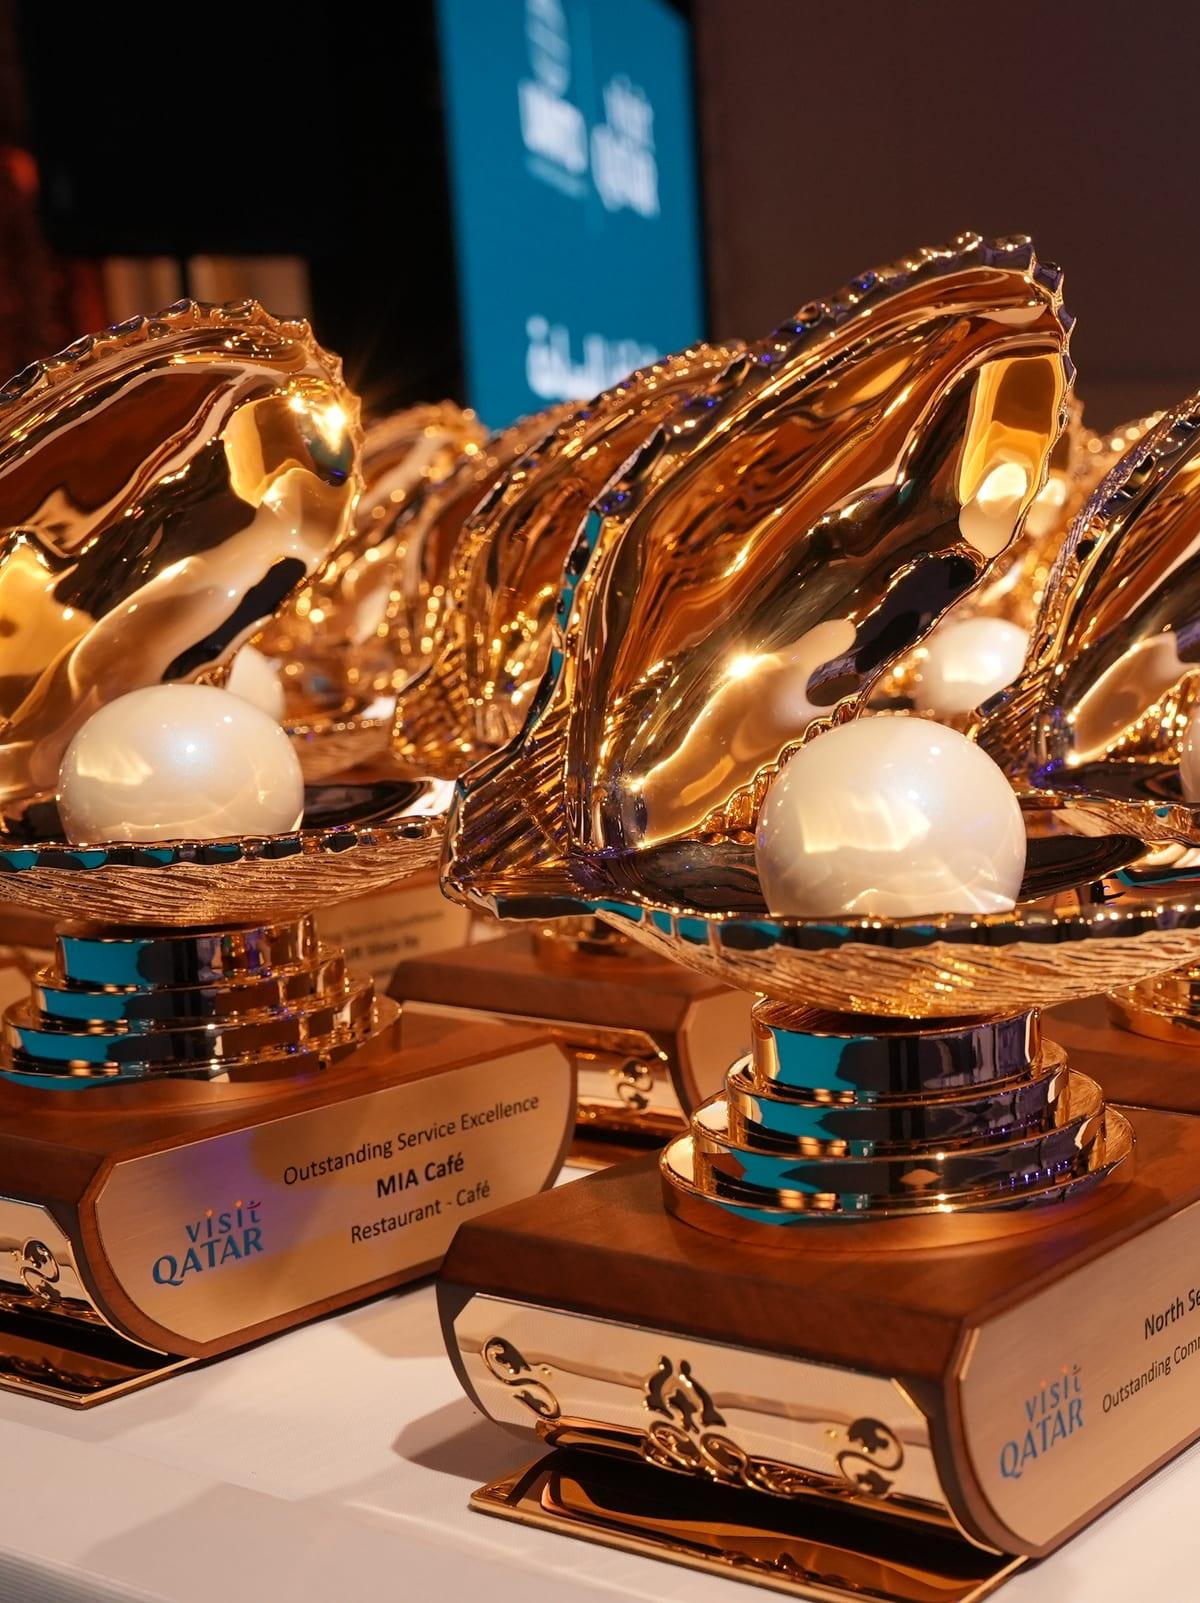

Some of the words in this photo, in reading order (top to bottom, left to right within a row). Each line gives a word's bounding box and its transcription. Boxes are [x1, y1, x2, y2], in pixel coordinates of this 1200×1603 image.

[283, 1137, 393, 1187] Outstanding
[397, 1121, 456, 1152] Service
[460, 1095, 540, 1131] Excellence
[376, 1168, 419, 1200] MIA
[424, 1153, 465, 1183] Café
[351, 1199, 441, 1245] Restaurant
[456, 1180, 491, 1207] Café
[152, 1228, 265, 1287] QATAR
[1144, 1298, 1184, 1340] North
[1102, 1354, 1171, 1414] Outstanding
[1000, 1398, 1085, 1479] QATAR
